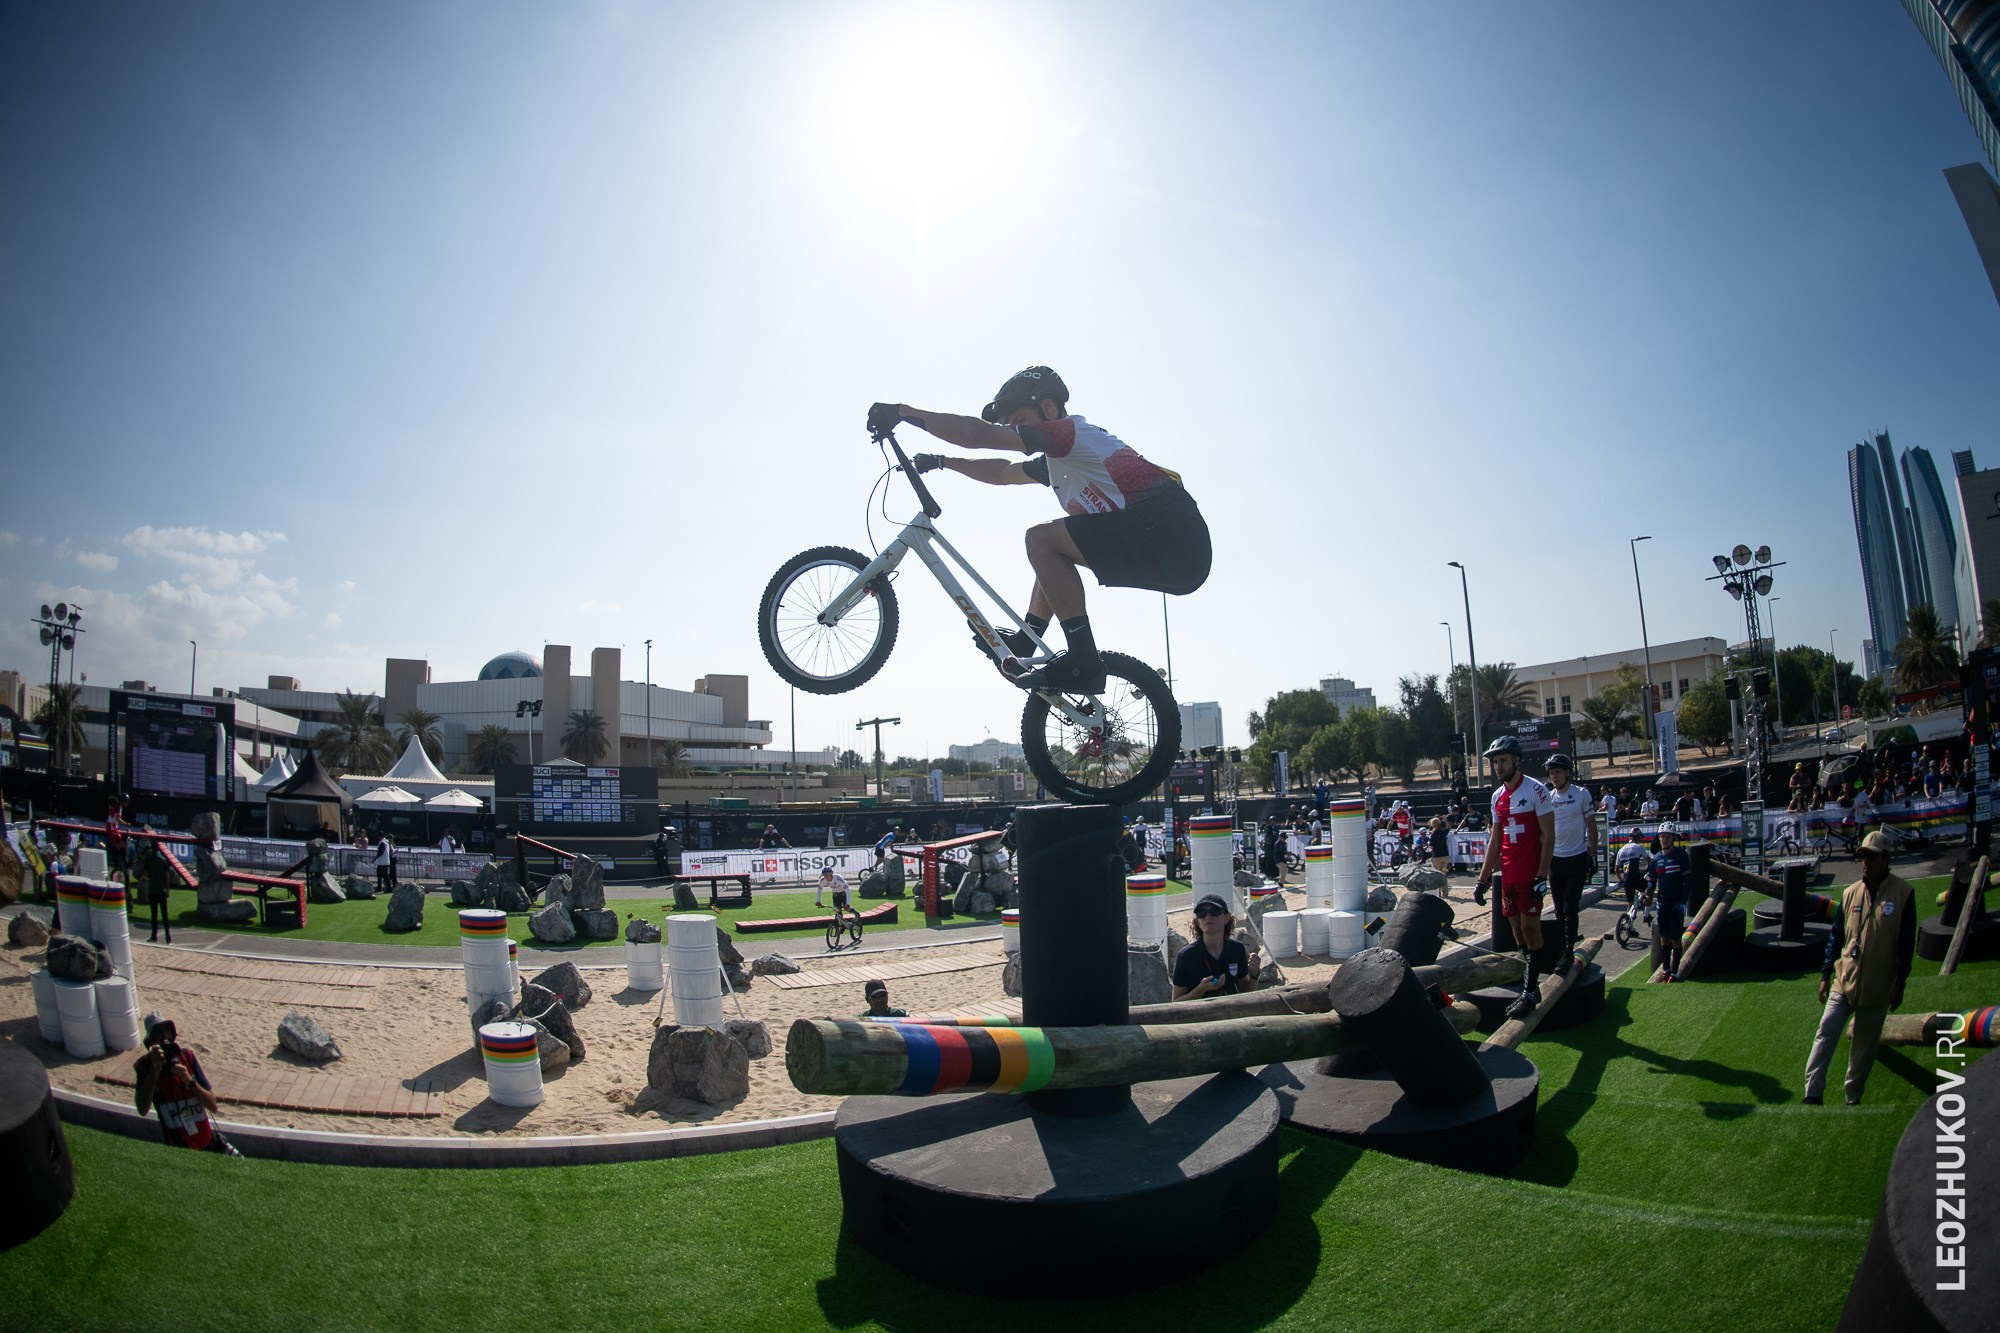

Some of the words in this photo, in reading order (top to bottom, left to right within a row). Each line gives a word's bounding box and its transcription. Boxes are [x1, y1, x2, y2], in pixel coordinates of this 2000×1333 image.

[955, 595, 1002, 648] CLEAN
[1517, 725, 1538, 733] FINISH
[536, 767, 550, 775] UCI
[1533, 784, 1548, 805] OKK
[1743, 813, 1762, 821] START
[1747, 821, 1757, 838] 3
[780, 855, 849, 872] TISSOT
